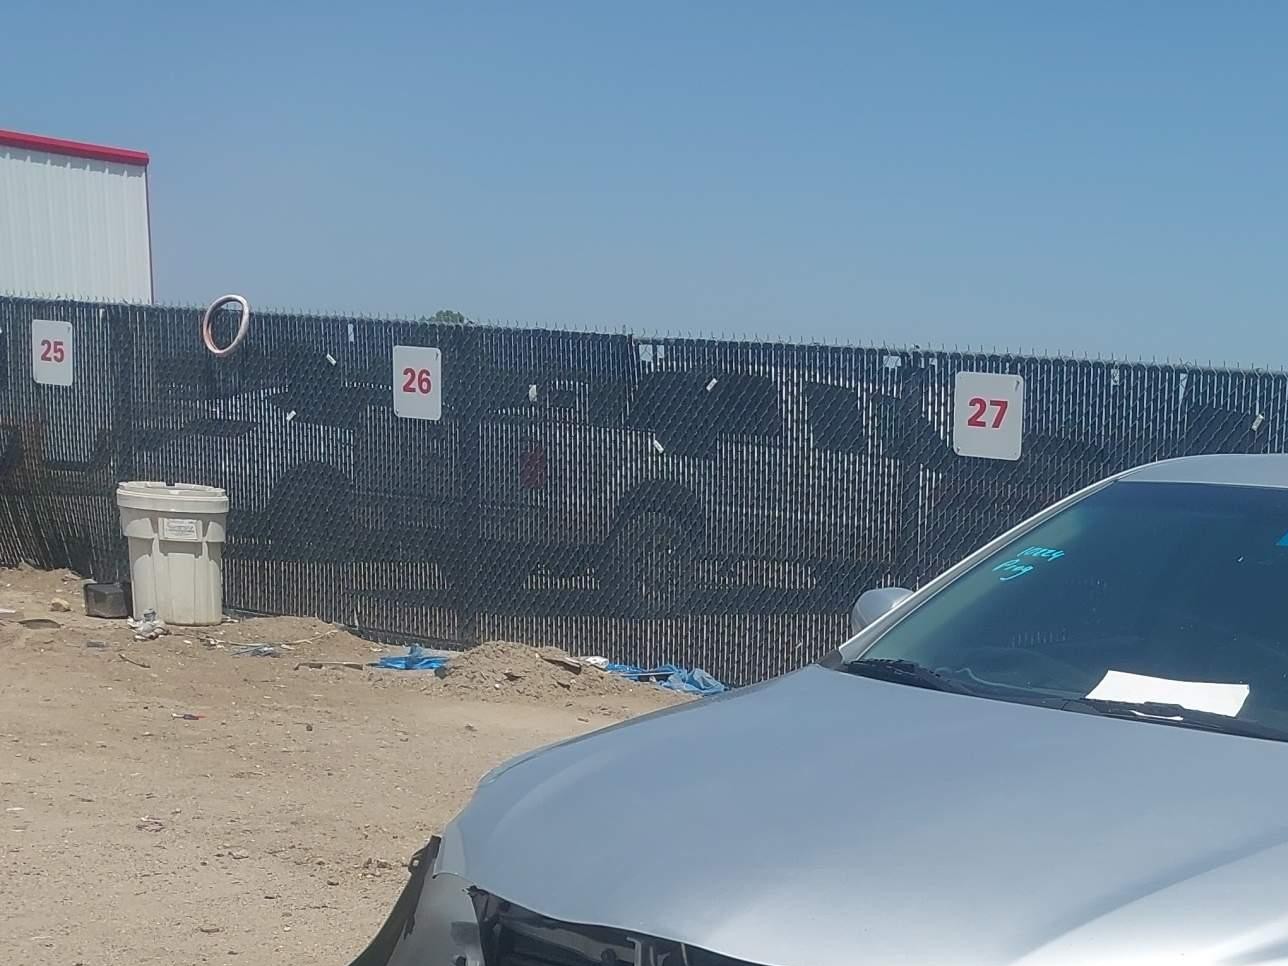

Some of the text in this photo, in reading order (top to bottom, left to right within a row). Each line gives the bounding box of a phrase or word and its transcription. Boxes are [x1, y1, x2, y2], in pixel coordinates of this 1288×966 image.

[41, 339, 65, 363] 25
[403, 367, 432, 395] 26
[967, 397, 1009, 429] 27
